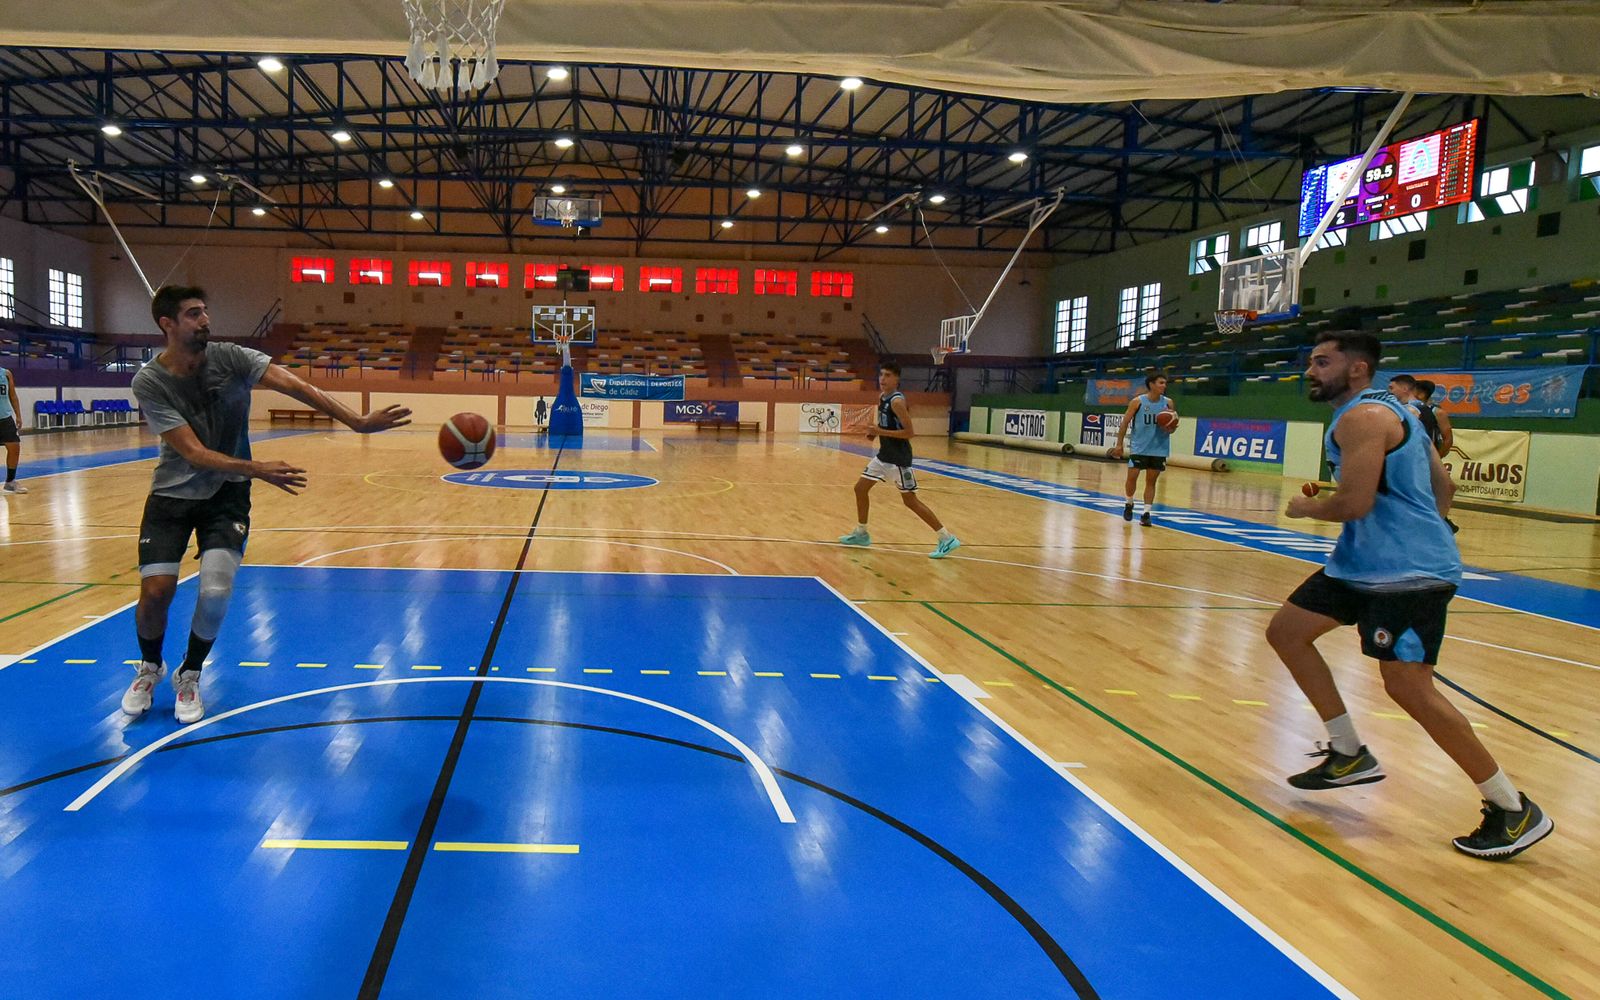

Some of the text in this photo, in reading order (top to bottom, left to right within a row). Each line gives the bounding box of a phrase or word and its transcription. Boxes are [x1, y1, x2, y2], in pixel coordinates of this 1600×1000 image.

[1365, 164, 1393, 182] 59.5
[1411, 193, 1421, 208] 0
[1336, 211, 1345, 225] 2
[591, 403, 608, 412] Diego
[675, 404, 703, 415] MGS
[801, 403, 825, 414] Casa
[1020, 413, 1046, 437] STROG
[1200, 430, 1278, 460] ÁNGEL
[1460, 461, 1523, 485] HIJOS
